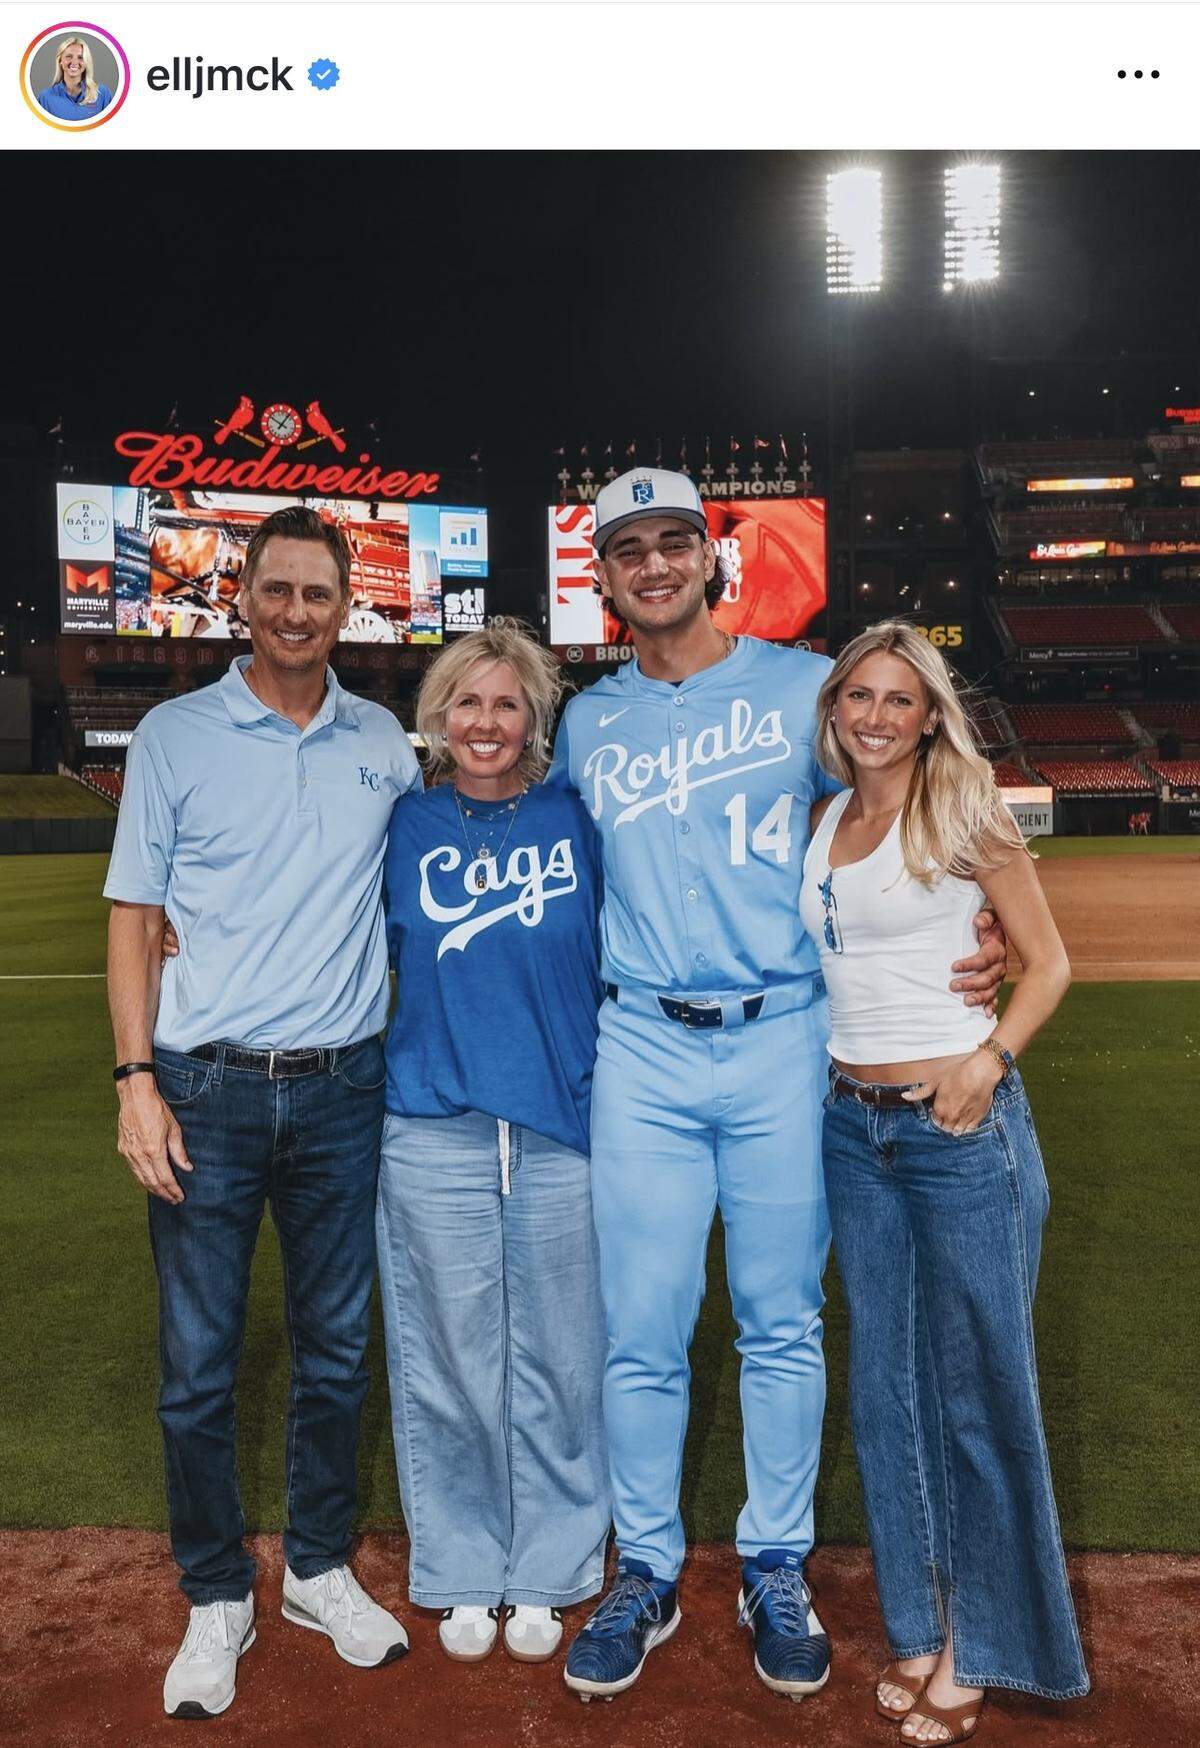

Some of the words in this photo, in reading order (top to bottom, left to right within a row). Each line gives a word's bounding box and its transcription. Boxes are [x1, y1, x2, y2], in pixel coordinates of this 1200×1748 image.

[114, 431, 439, 497] Budweiser
[700, 480, 796, 496] AMPIONS
[67, 518, 105, 526] BAYER
[66, 597, 109, 606] MARYVILLE
[444, 588, 485, 614] stl
[64, 621, 113, 630] maryville.edu
[445, 614, 485, 624] TODAY
[95, 733, 133, 744] TODAY
[584, 700, 791, 820] Royals
[358, 767, 379, 791] KC
[725, 793, 793, 865] 14
[419, 839, 577, 930] Cags
